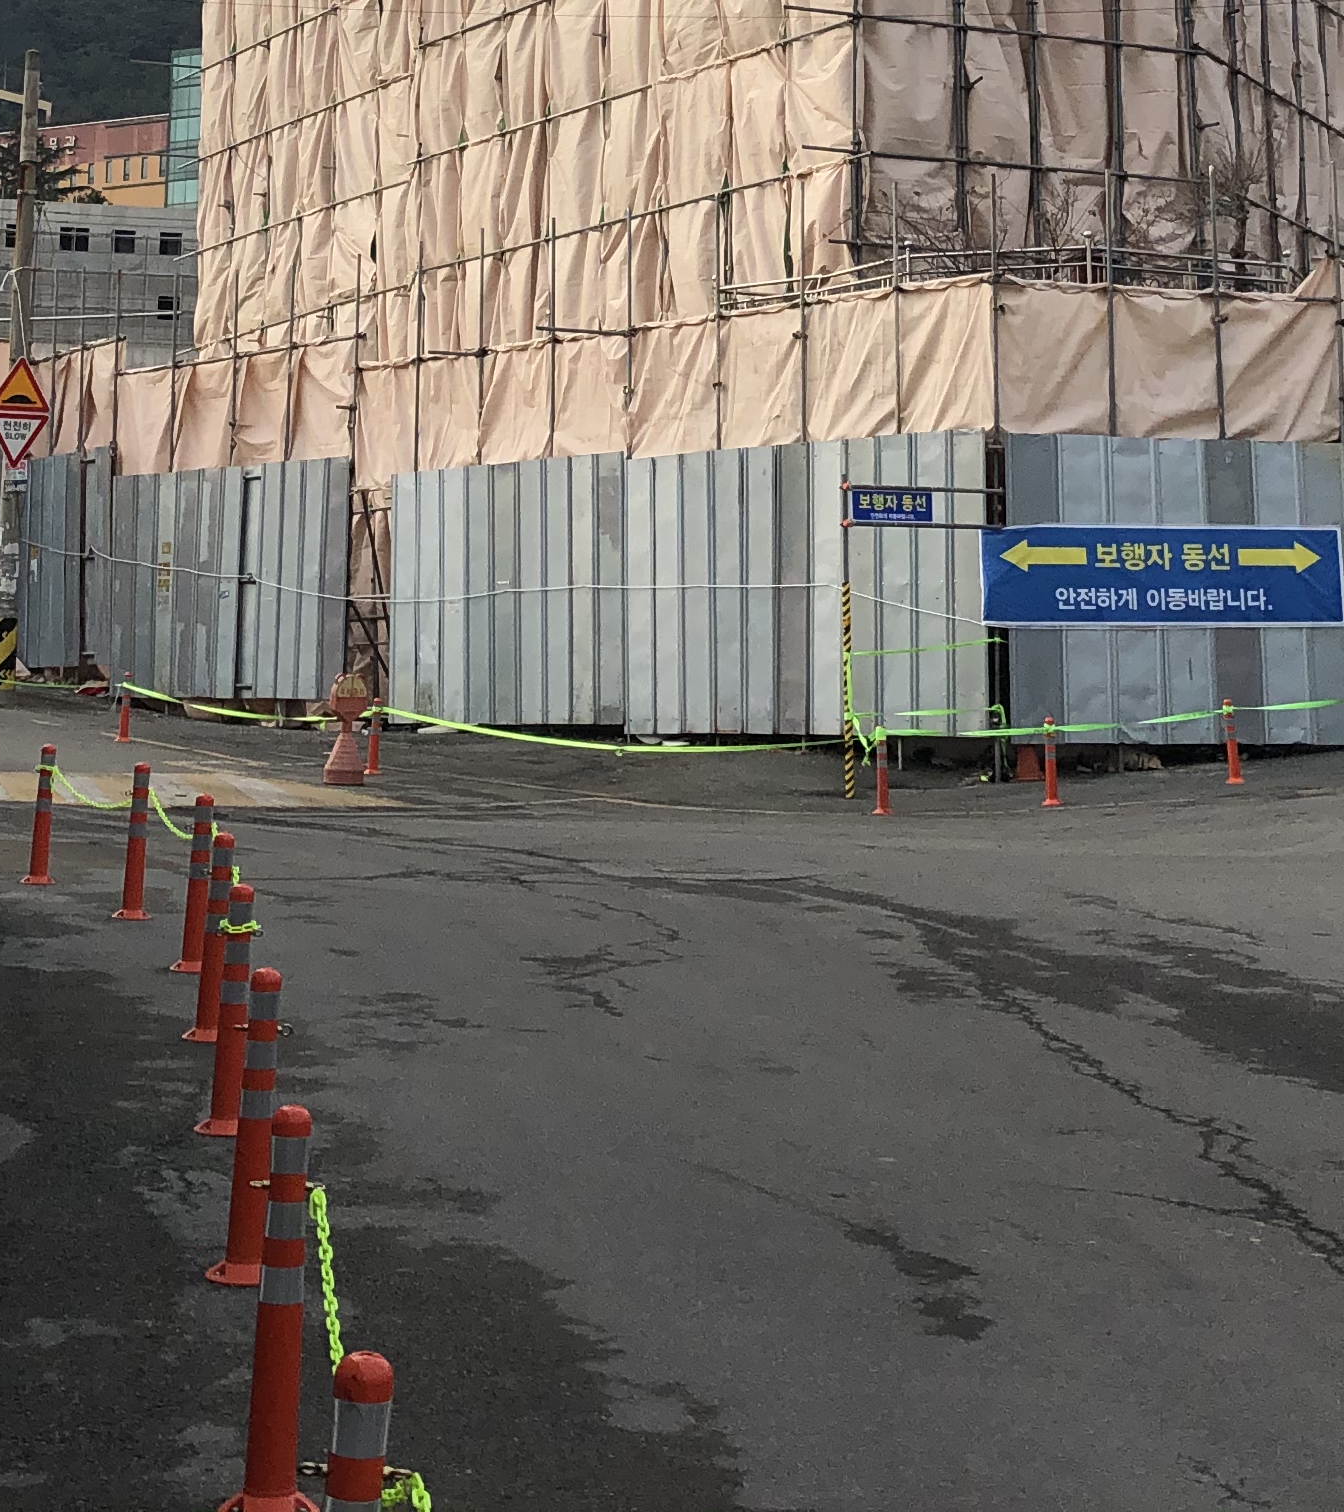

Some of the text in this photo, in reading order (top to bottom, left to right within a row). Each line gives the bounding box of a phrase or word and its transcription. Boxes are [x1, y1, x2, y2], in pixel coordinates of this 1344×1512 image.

[3, 421, 32, 432] 천천히
[4, 432, 27, 440] SLOW
[859, 493, 927, 512] 보행자 동선
[1095, 542, 1230, 571] 보행자 동선
[1055, 587, 1273, 611] 안전하게 이동바랍니다.
